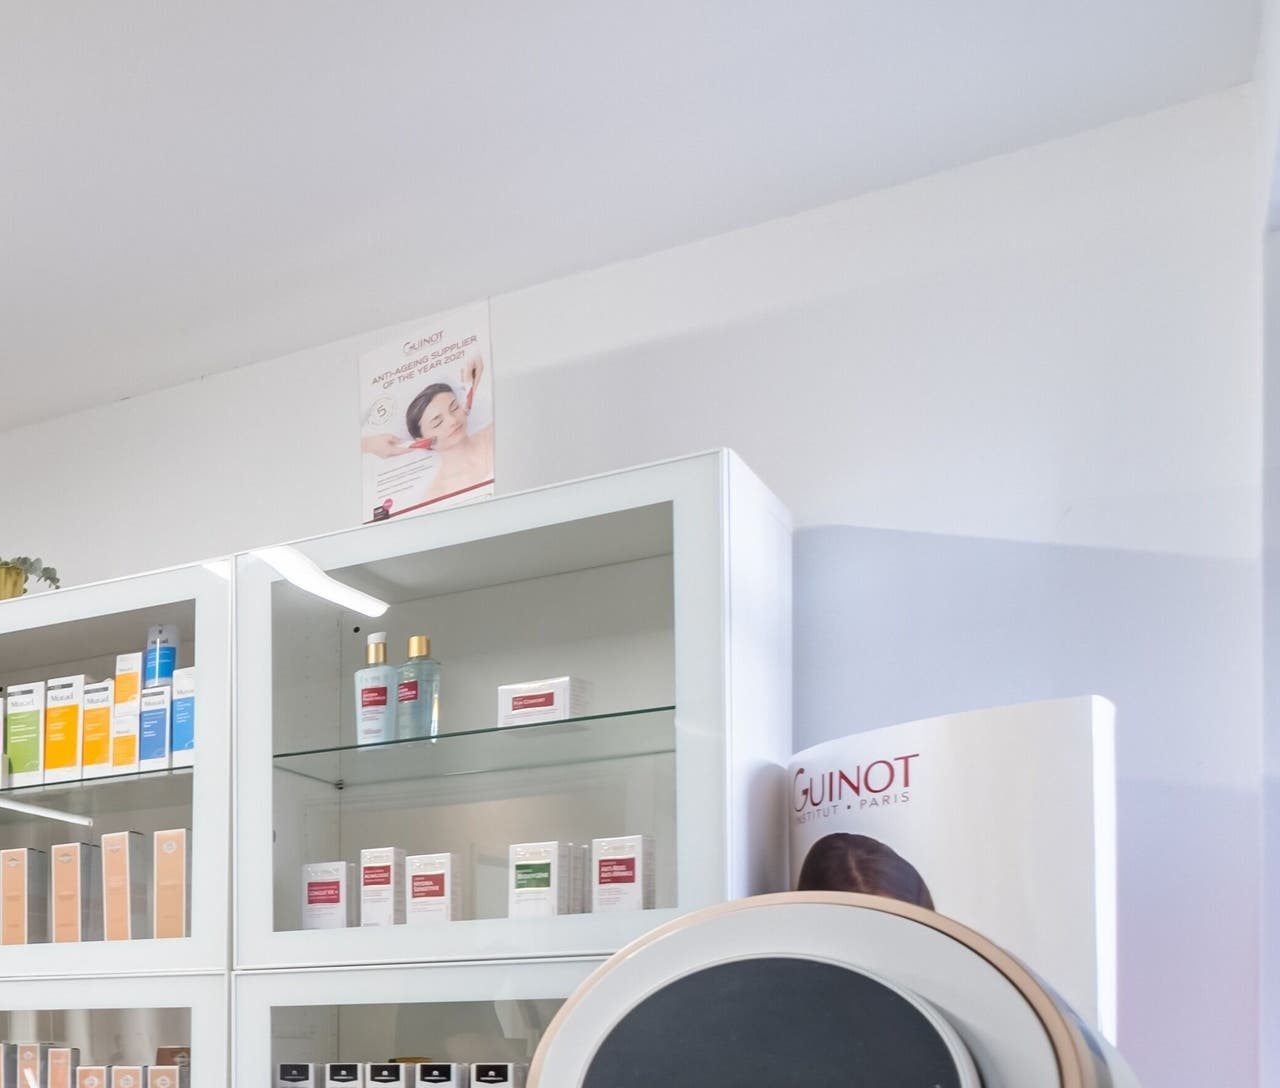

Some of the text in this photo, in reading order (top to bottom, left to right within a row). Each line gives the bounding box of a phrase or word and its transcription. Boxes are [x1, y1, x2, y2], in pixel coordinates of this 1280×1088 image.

[371, 335, 478, 385] ANTI-AGEING SUPPLIER
[397, 372, 416, 383] THE
[417, 359, 442, 376] YEAR
[793, 753, 920, 813] GUINOT
[860, 791, 910, 810] PARIS
